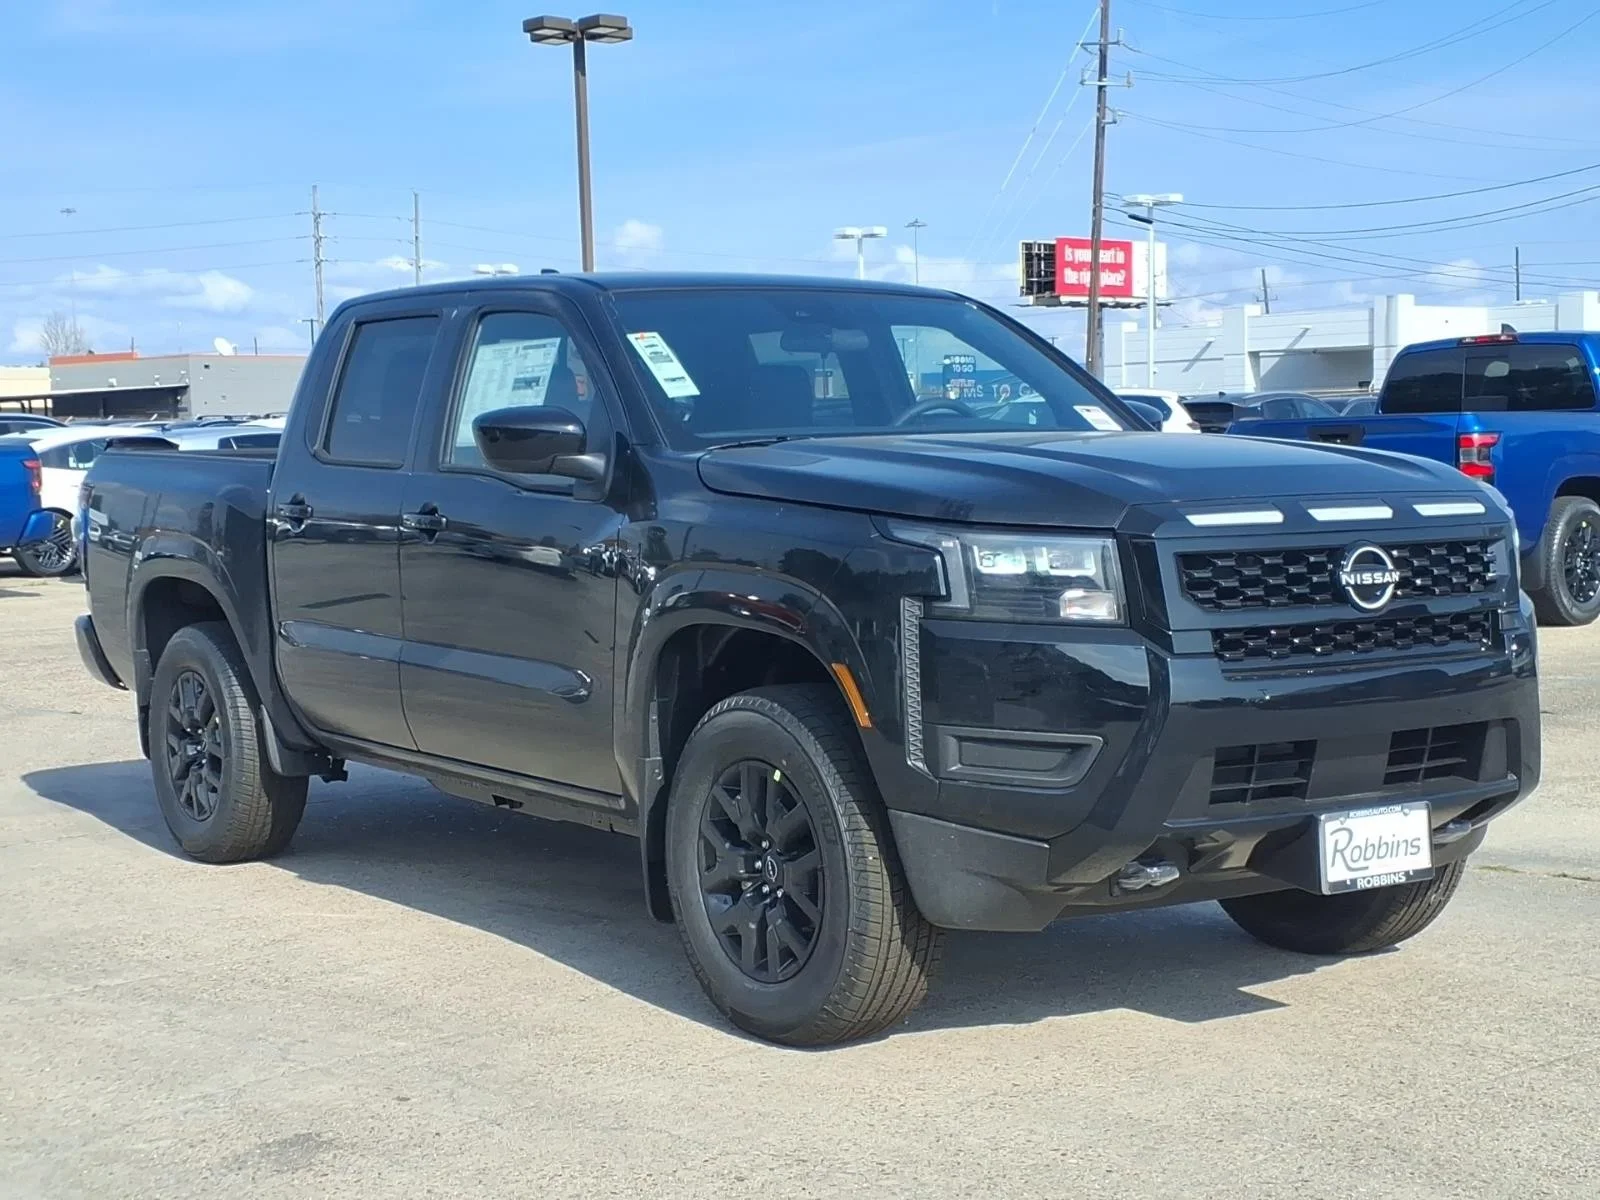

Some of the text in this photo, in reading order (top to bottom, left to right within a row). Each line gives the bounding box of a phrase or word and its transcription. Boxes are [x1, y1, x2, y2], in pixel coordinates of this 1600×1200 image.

[1116, 247, 1125, 265] in
[1064, 267, 1079, 284] the
[1100, 269, 1126, 288] place?
[1341, 571, 1400, 585] NISSAN
[1329, 827, 1421, 872] Robbins
[1356, 872, 1406, 889] ROBBINS
